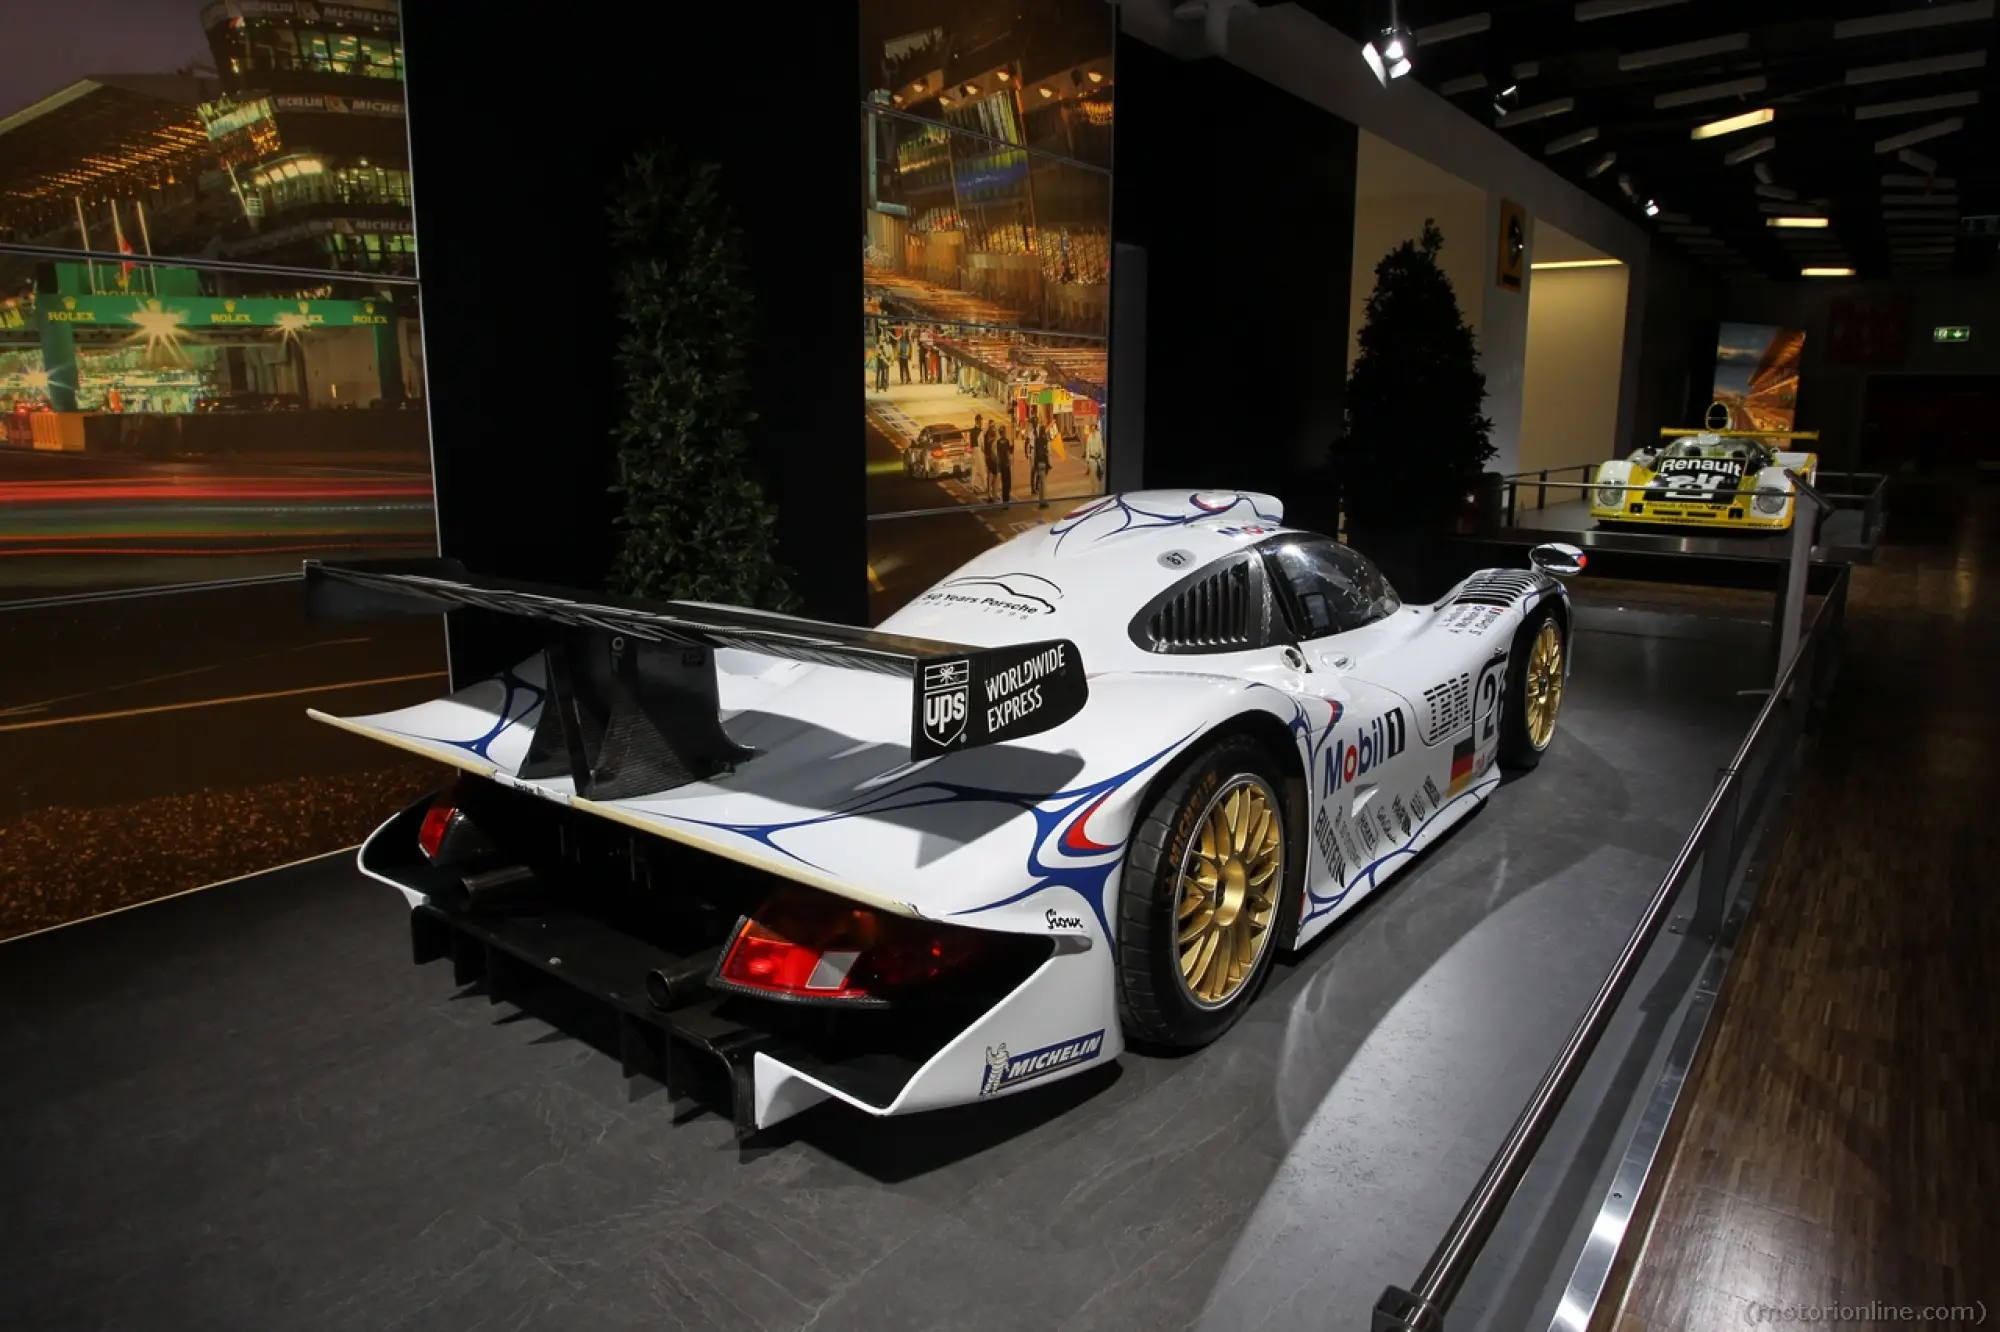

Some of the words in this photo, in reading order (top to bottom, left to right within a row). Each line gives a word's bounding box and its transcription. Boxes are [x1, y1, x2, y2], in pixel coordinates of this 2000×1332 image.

[323, 6, 399, 25] MICHELIN
[48, 311, 96, 322] ROLEX
[210, 314, 252, 323] ROLEX
[352, 315, 388, 325] ROLEX
[1661, 458, 1742, 477] Renault
[981, 597, 1038, 614] Porsche
[984, 643, 1065, 701] WORLDWIDE
[926, 692, 966, 734] ups
[986, 684, 1043, 733] EXPRESS
[1423, 672, 1470, 741] IBM
[1323, 716, 1384, 800] Mobil
[1314, 804, 1345, 889] BILSTEIN
[1044, 908, 1084, 930] Sioux
[1007, 1035, 1102, 1080] MICHELIN
